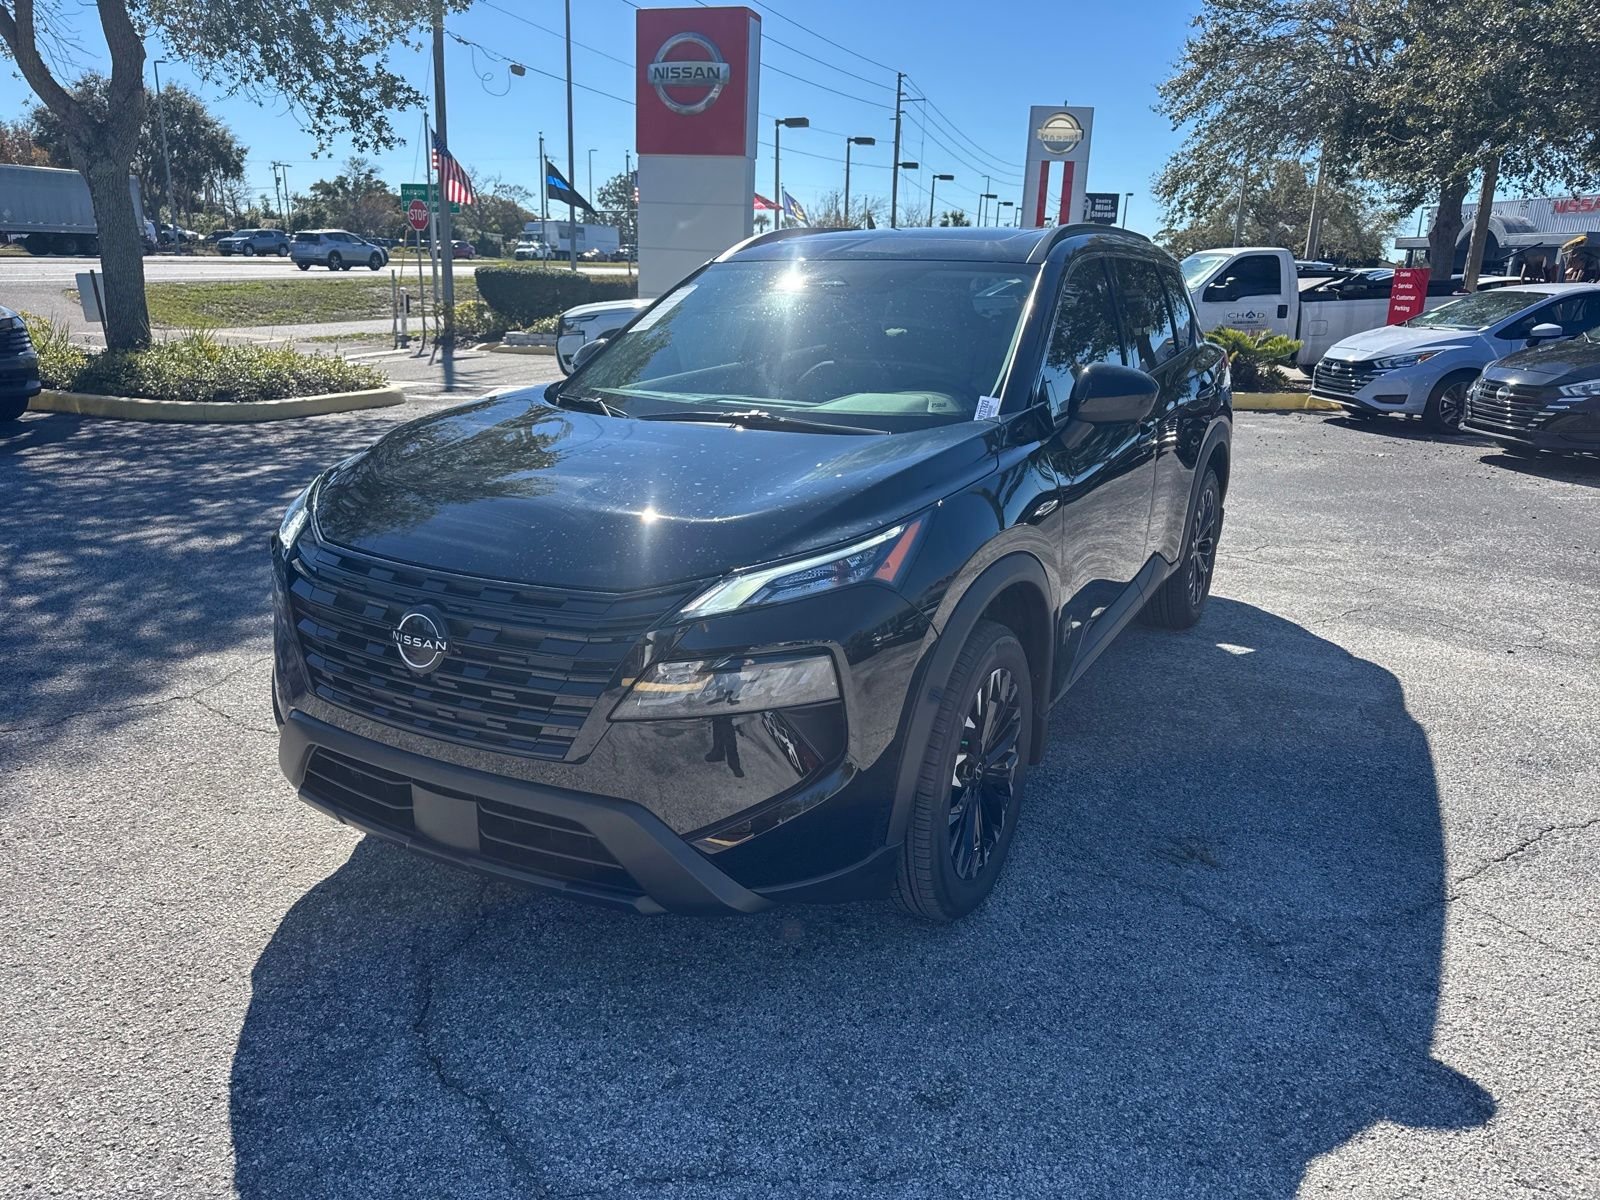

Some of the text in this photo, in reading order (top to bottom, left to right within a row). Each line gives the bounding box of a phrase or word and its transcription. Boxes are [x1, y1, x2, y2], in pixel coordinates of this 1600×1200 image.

[653, 66, 720, 79] NISSAN
[410, 209, 427, 220] STOP
[392, 630, 447, 651] NISSAN
